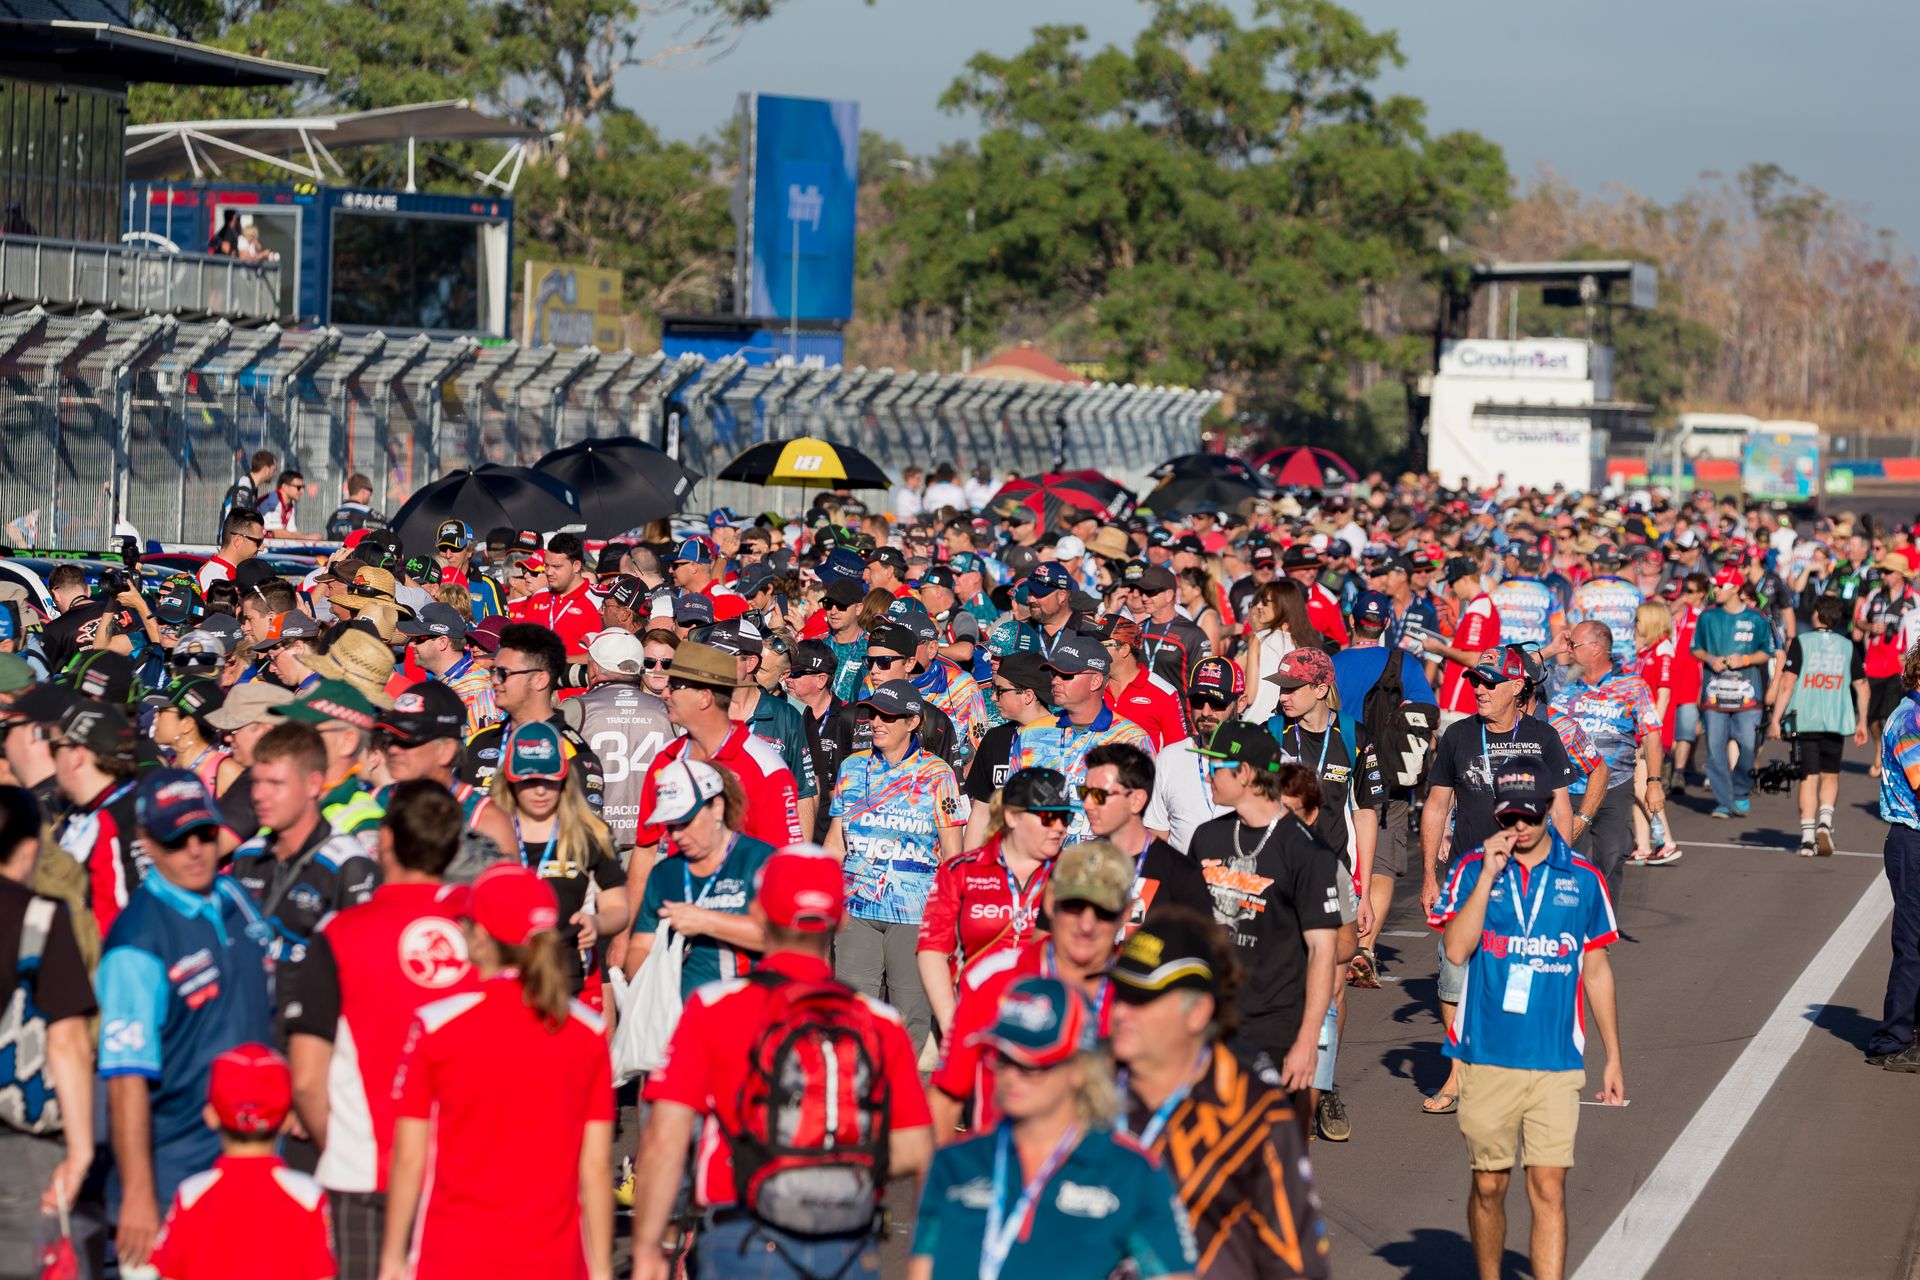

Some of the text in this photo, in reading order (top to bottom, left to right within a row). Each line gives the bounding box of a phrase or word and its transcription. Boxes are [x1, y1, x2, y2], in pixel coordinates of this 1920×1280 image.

[812, 657, 823, 668] 17
[1803, 673, 1845, 690] HOST
[606, 717, 652, 725] TRACK ONLY
[590, 730, 664, 783] 34
[860, 812, 933, 835] DARWIN
[1529, 958, 1573, 977] Racing
